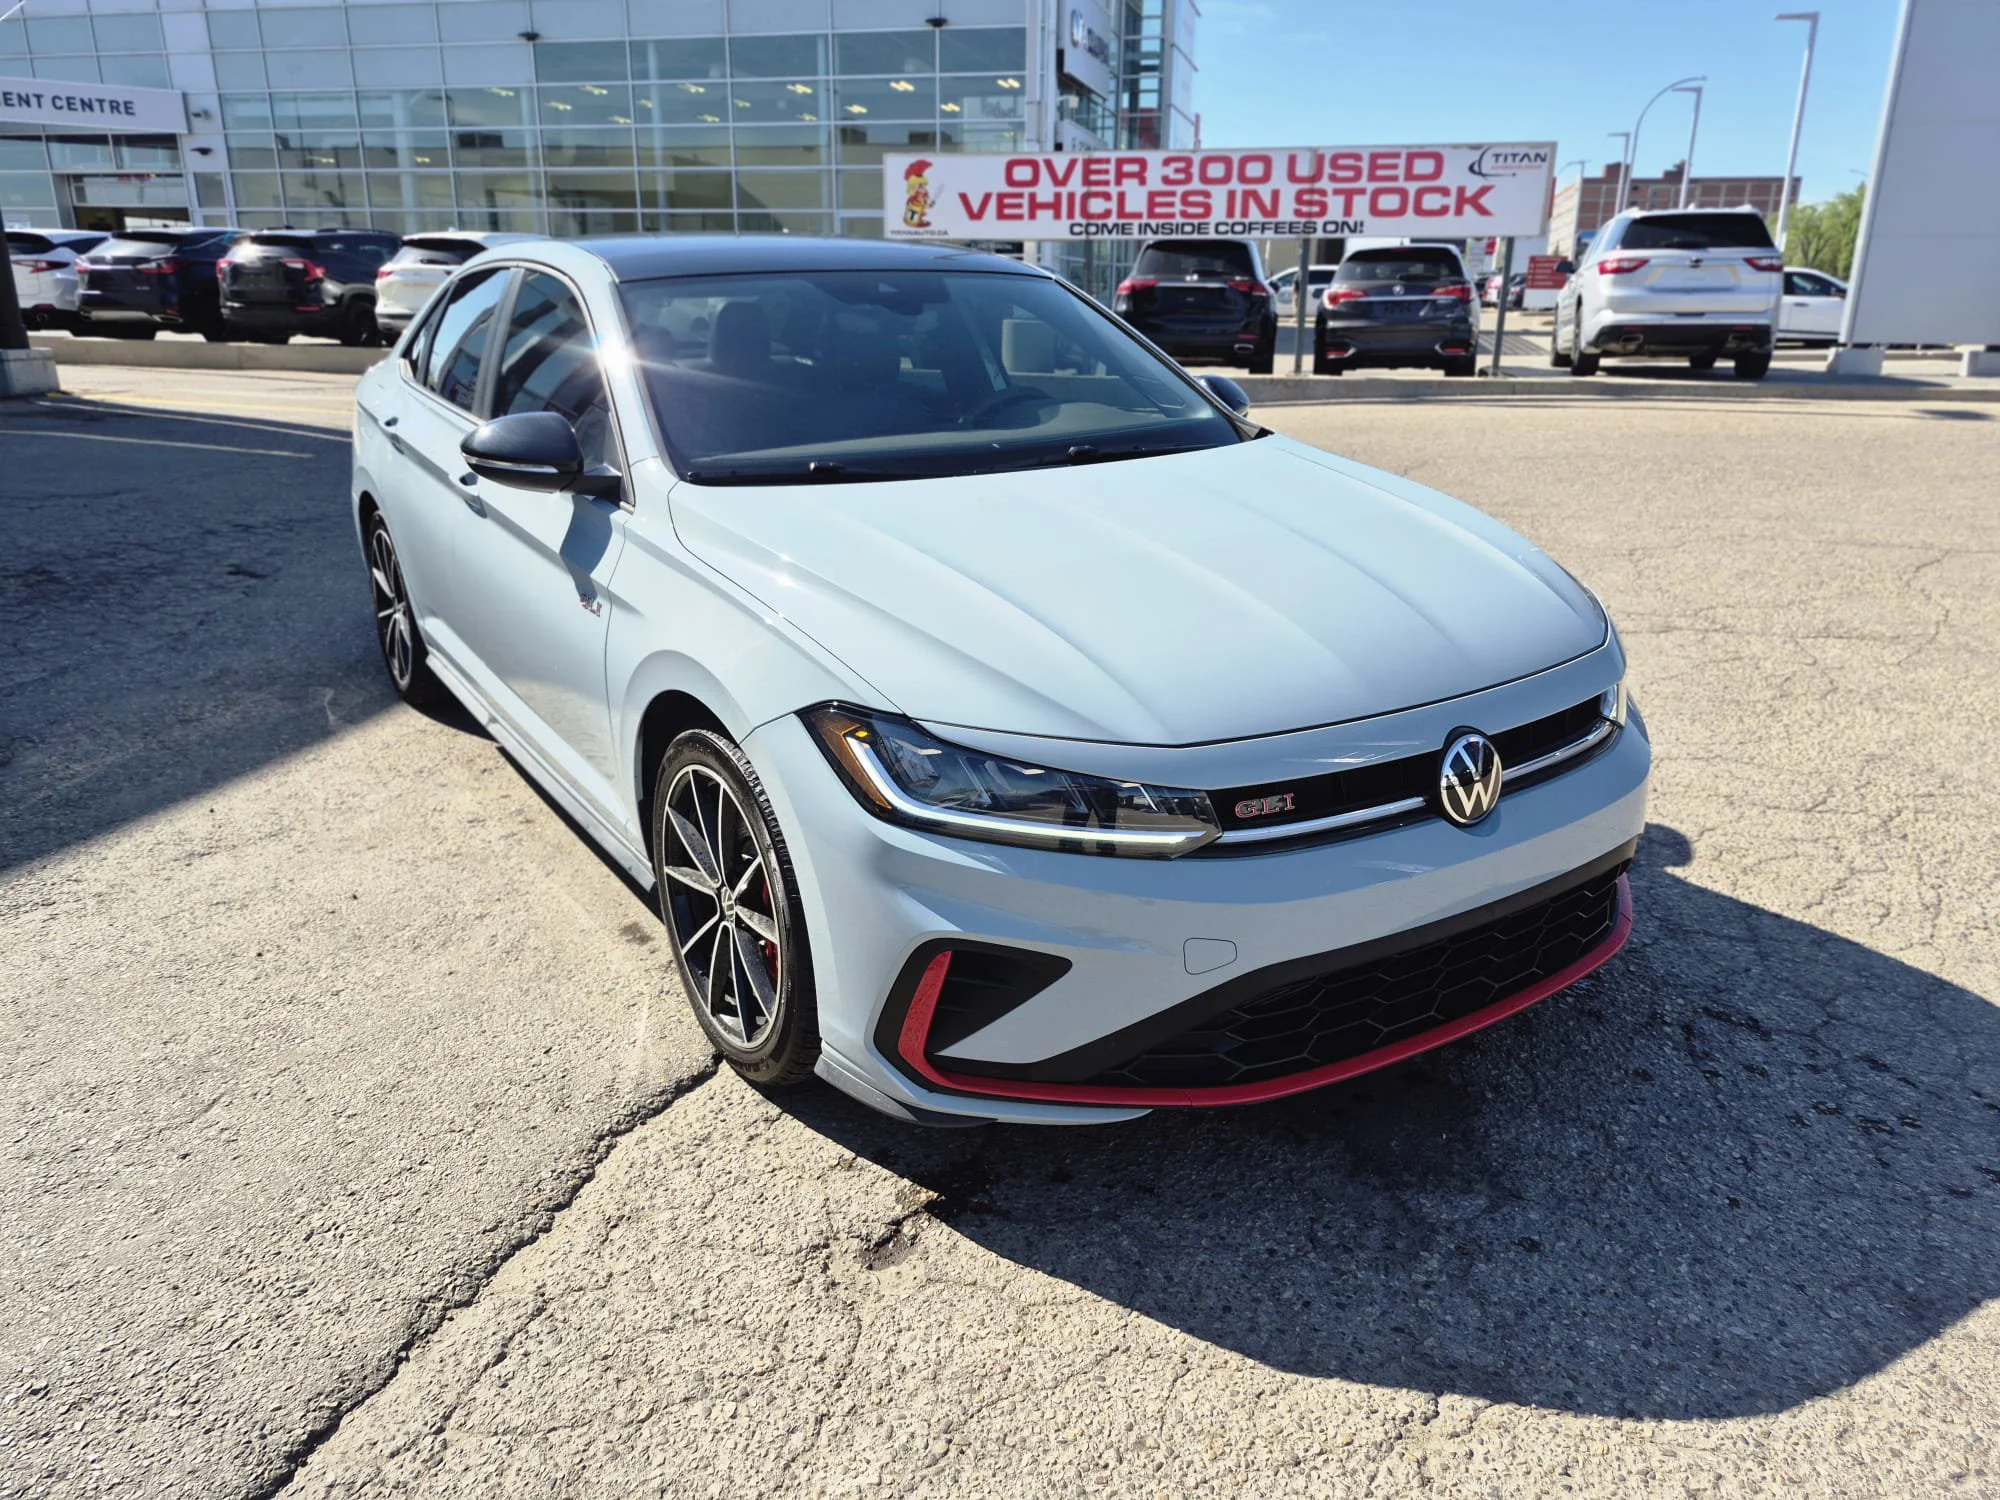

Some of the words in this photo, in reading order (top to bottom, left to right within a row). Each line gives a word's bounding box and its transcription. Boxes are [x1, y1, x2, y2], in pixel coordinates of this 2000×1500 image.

[0, 90, 44, 109] ENT
[51, 95, 136, 116] CENTRE
[1004, 157, 1149, 188] OVER
[1161, 154, 1272, 186] 300
[1286, 151, 1444, 184] USED
[1492, 152, 1547, 163] TITAN
[958, 189, 1213, 221] VEHICLES
[1225, 188, 1280, 219] IN
[1293, 184, 1496, 218] STOCK
[1069, 222, 1132, 236] COME
[1138, 222, 1209, 236] INSIDE
[1214, 220, 1317, 236] COFFEES
[1322, 220, 1365, 234] ON!
[1234, 793, 1295, 818] GLI
